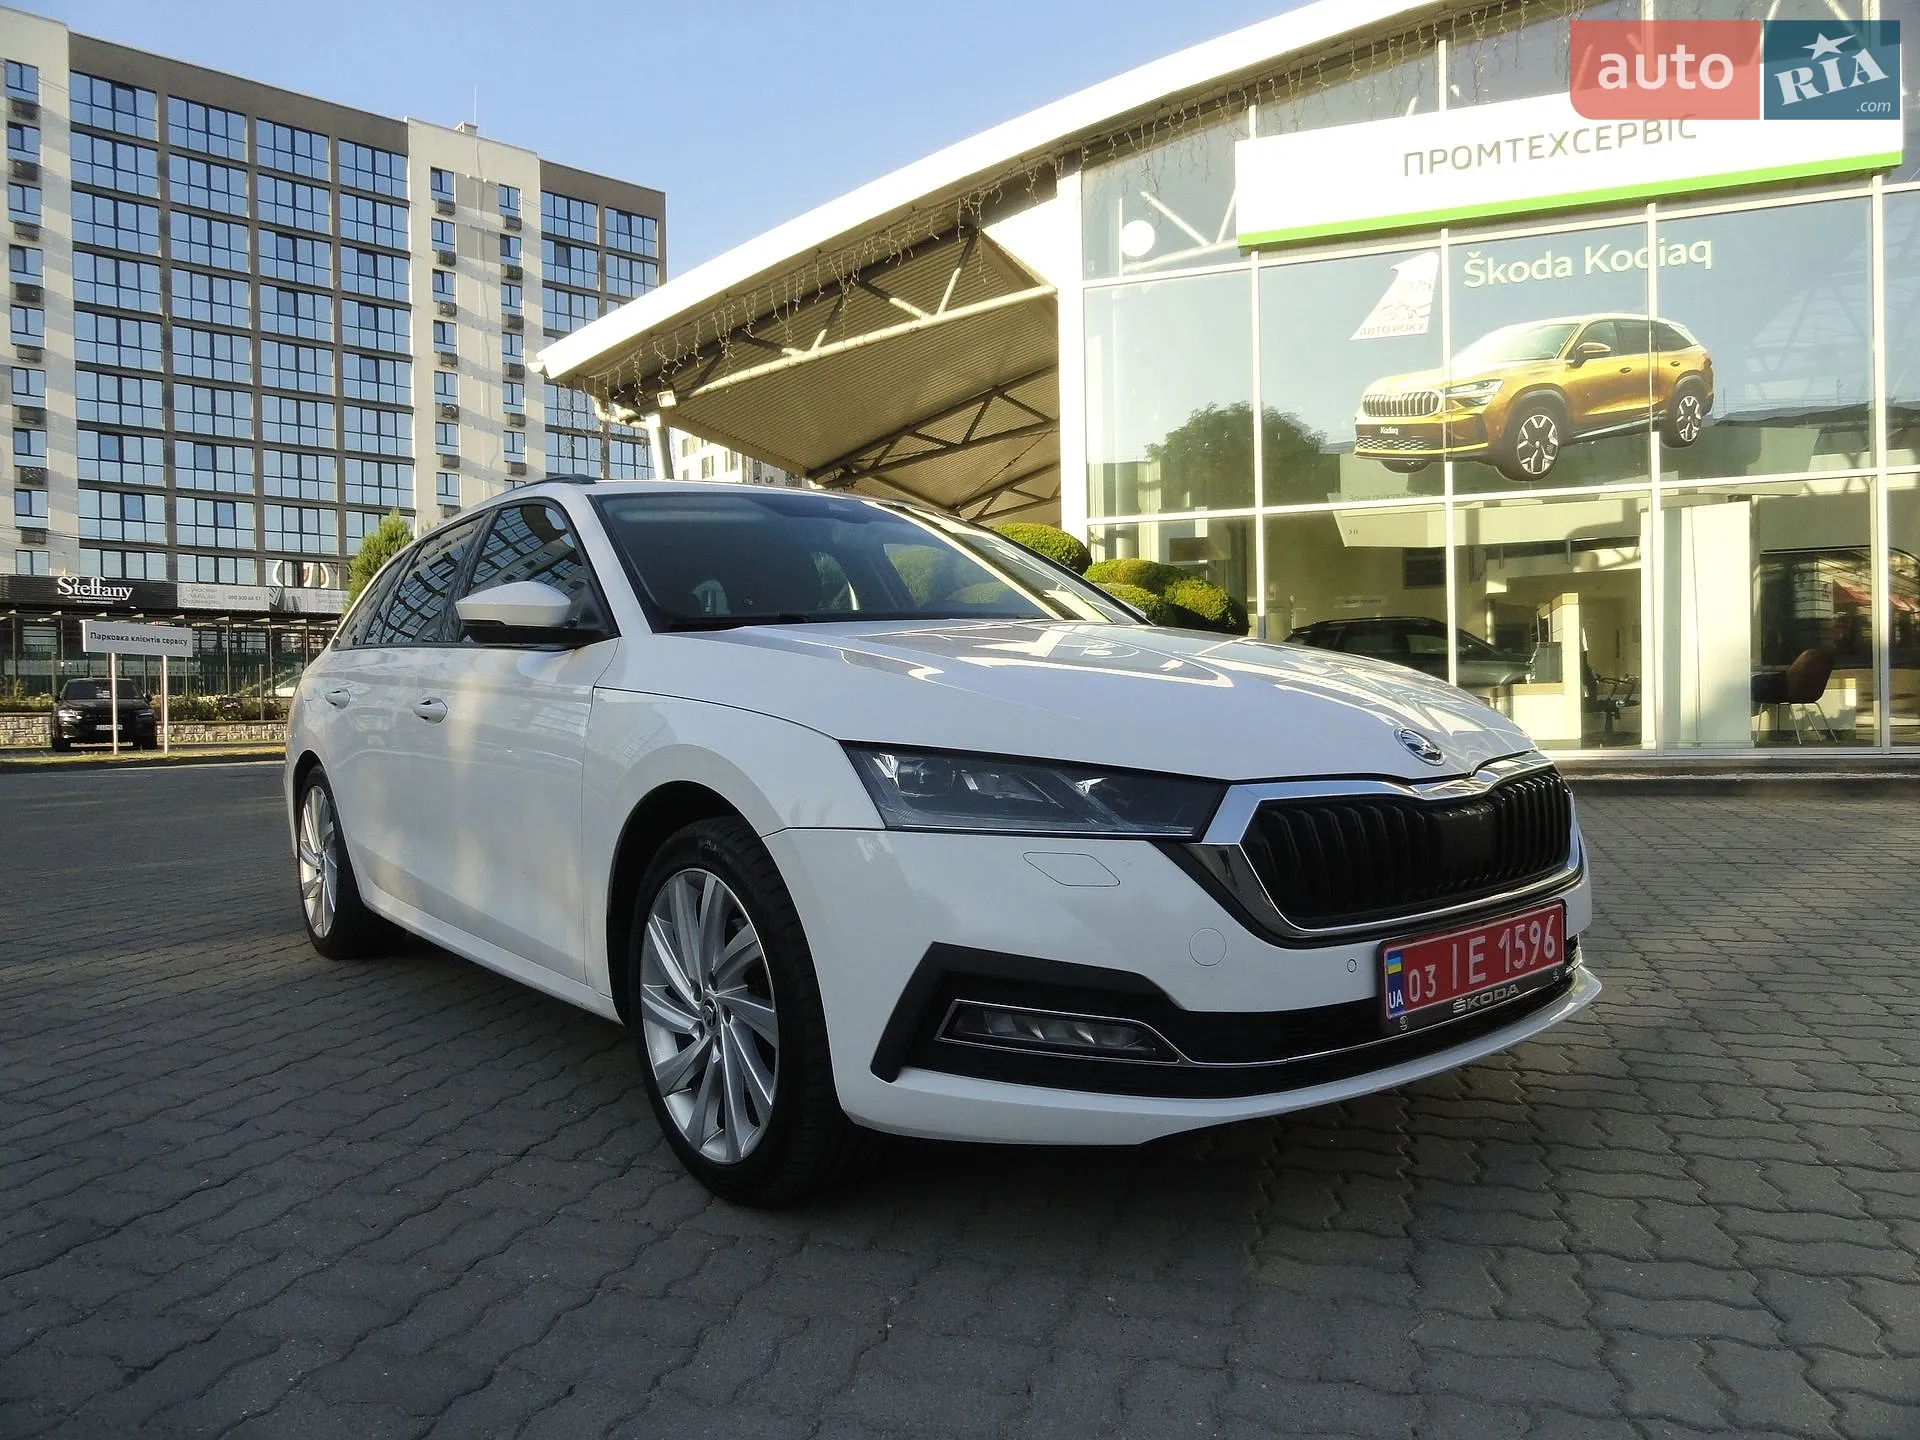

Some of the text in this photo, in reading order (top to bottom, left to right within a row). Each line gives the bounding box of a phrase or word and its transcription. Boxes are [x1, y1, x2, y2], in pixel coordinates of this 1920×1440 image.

[1404, 113, 1697, 176] ПРОМТЕХСЕРВІС
[1464, 250, 1573, 288] Škoda
[57, 576, 134, 600] Steffany
[90, 632, 188, 647] Парковка клієнтів сервісу
[1408, 914, 1555, 1003] 03 IE 1596
[1388, 990, 1404, 1009] UA
[1452, 983, 1519, 1014] ŠKODA
